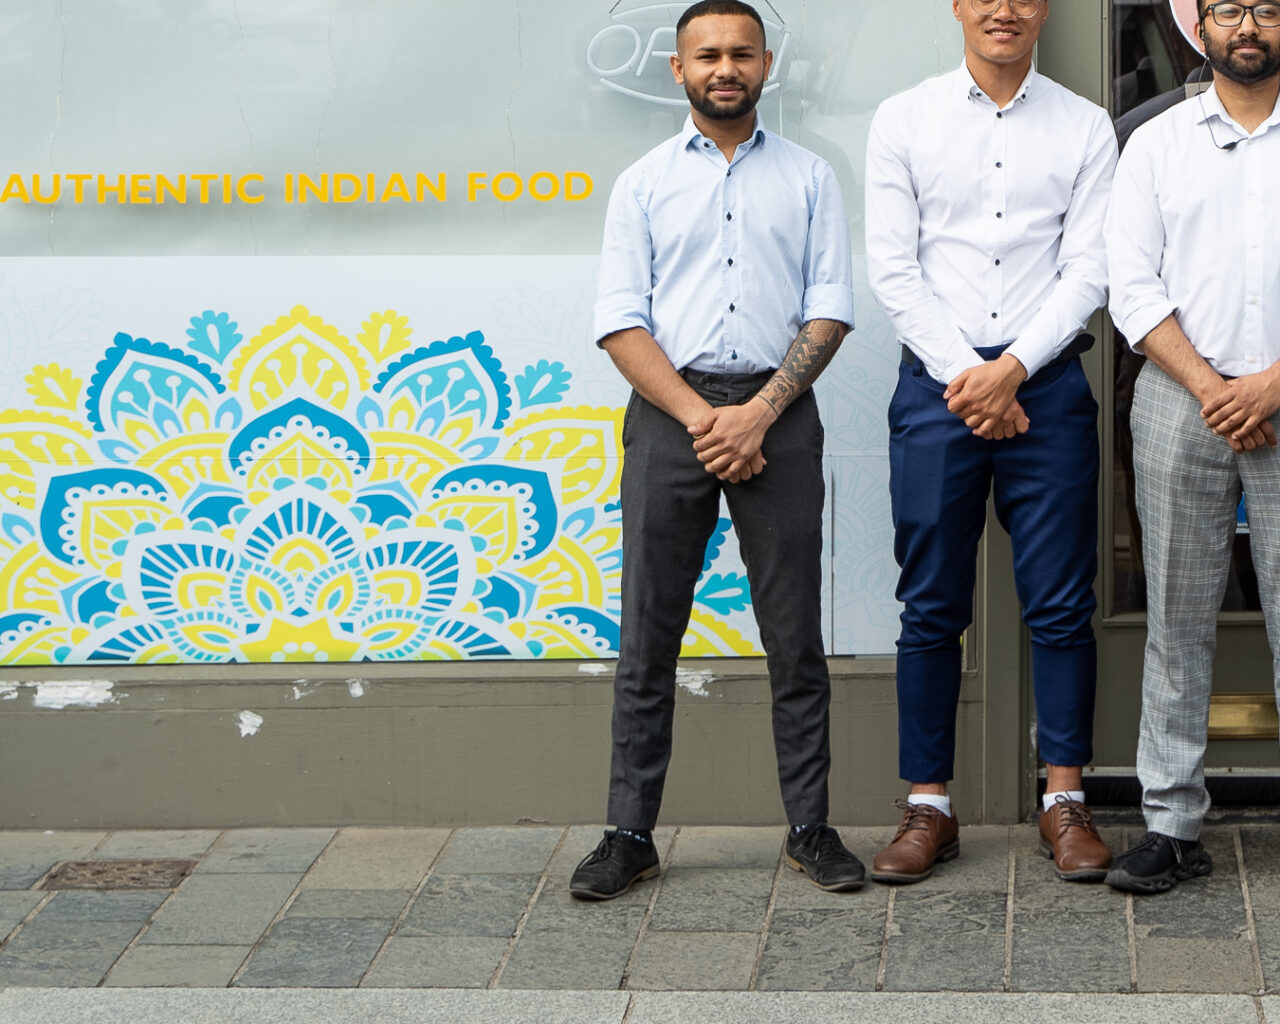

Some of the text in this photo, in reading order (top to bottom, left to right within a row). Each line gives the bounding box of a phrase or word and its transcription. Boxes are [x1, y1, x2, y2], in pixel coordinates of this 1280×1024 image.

[0, 170, 594, 205] AUTHENTIC INDIAN FOOD
